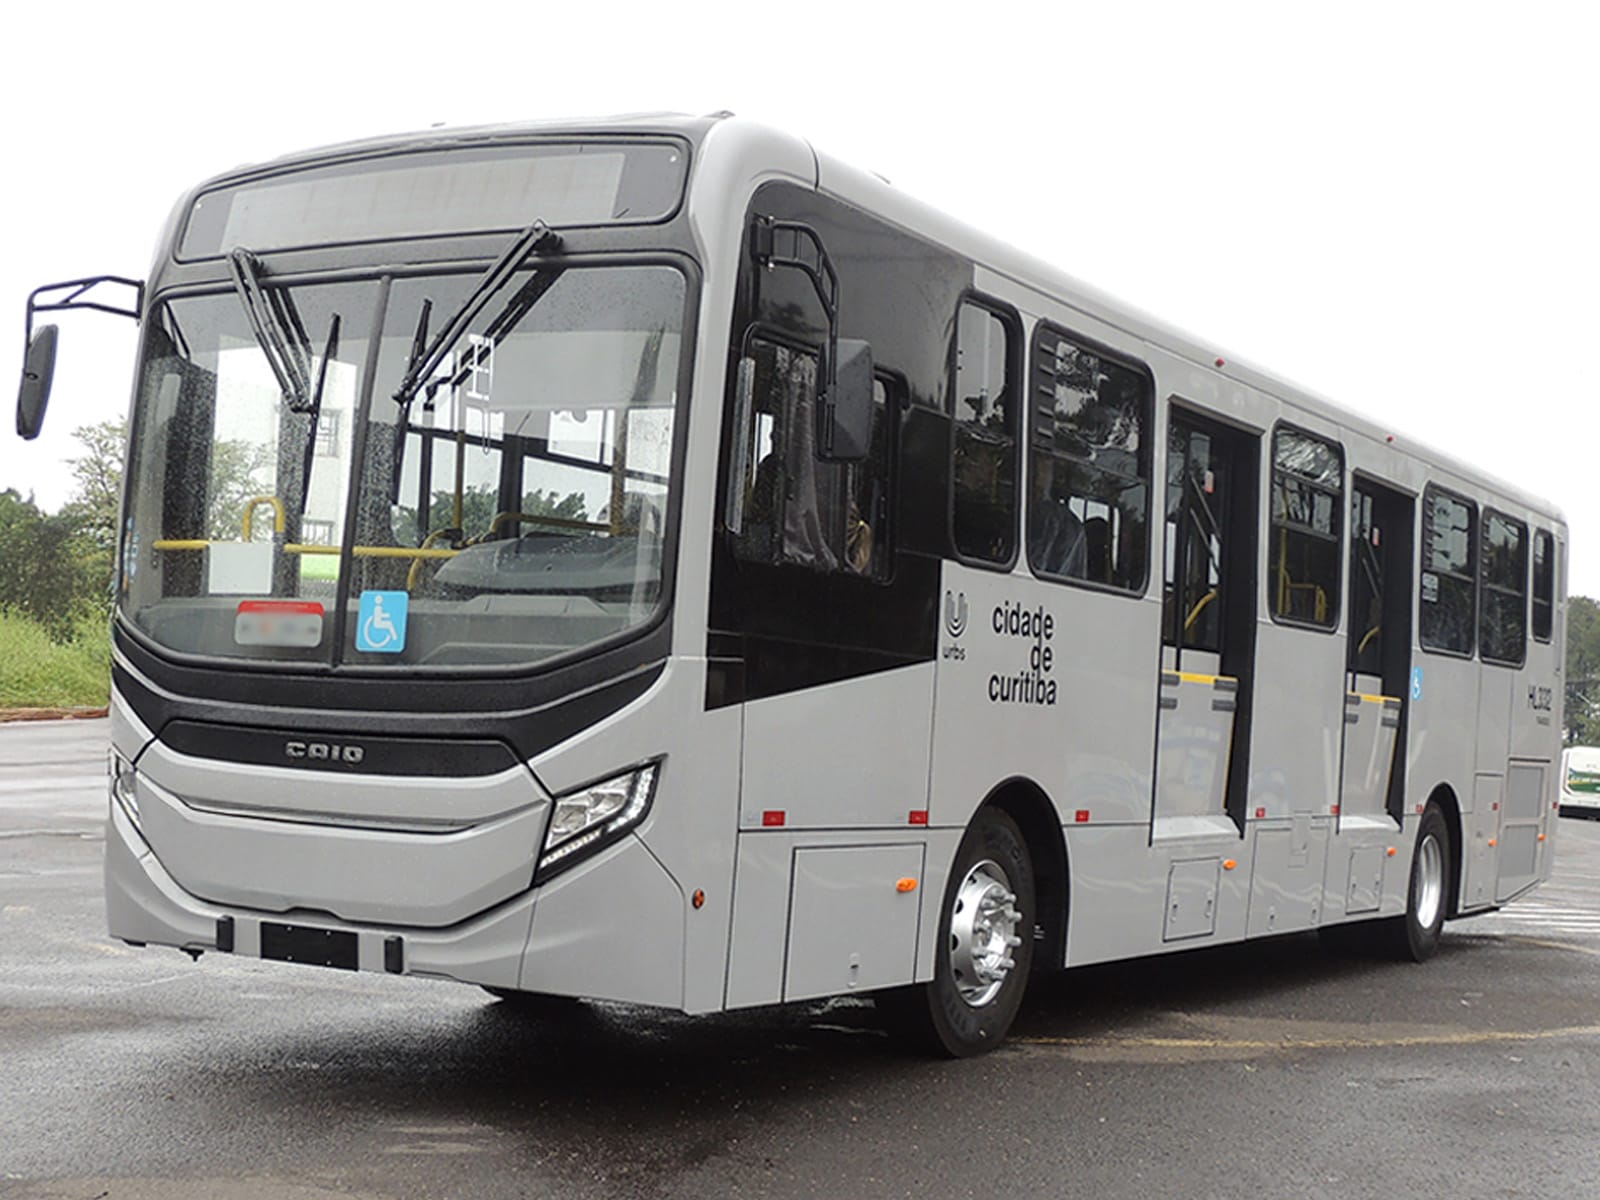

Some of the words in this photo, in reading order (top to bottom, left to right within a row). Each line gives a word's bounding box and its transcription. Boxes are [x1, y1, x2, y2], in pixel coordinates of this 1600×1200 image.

[992, 600, 1054, 639] cidade
[1030, 638, 1053, 672] de
[988, 671, 1057, 705] curitiba
[285, 741, 364, 763] CAIO
